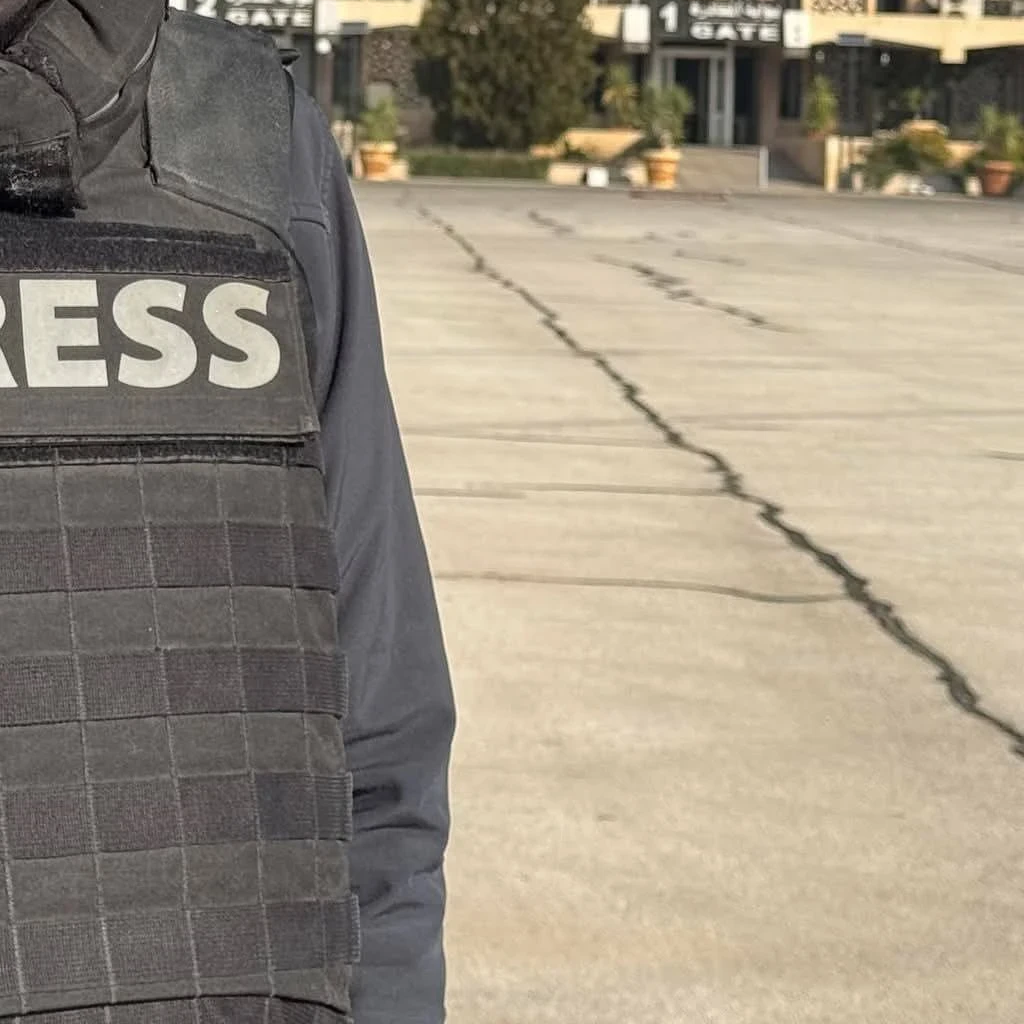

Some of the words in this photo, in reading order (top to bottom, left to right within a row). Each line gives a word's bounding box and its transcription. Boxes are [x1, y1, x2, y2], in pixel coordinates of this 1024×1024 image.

[224, 7, 313, 27] GATE
[659, 2, 679, 33] 1
[689, 21, 781, 42] GATE
